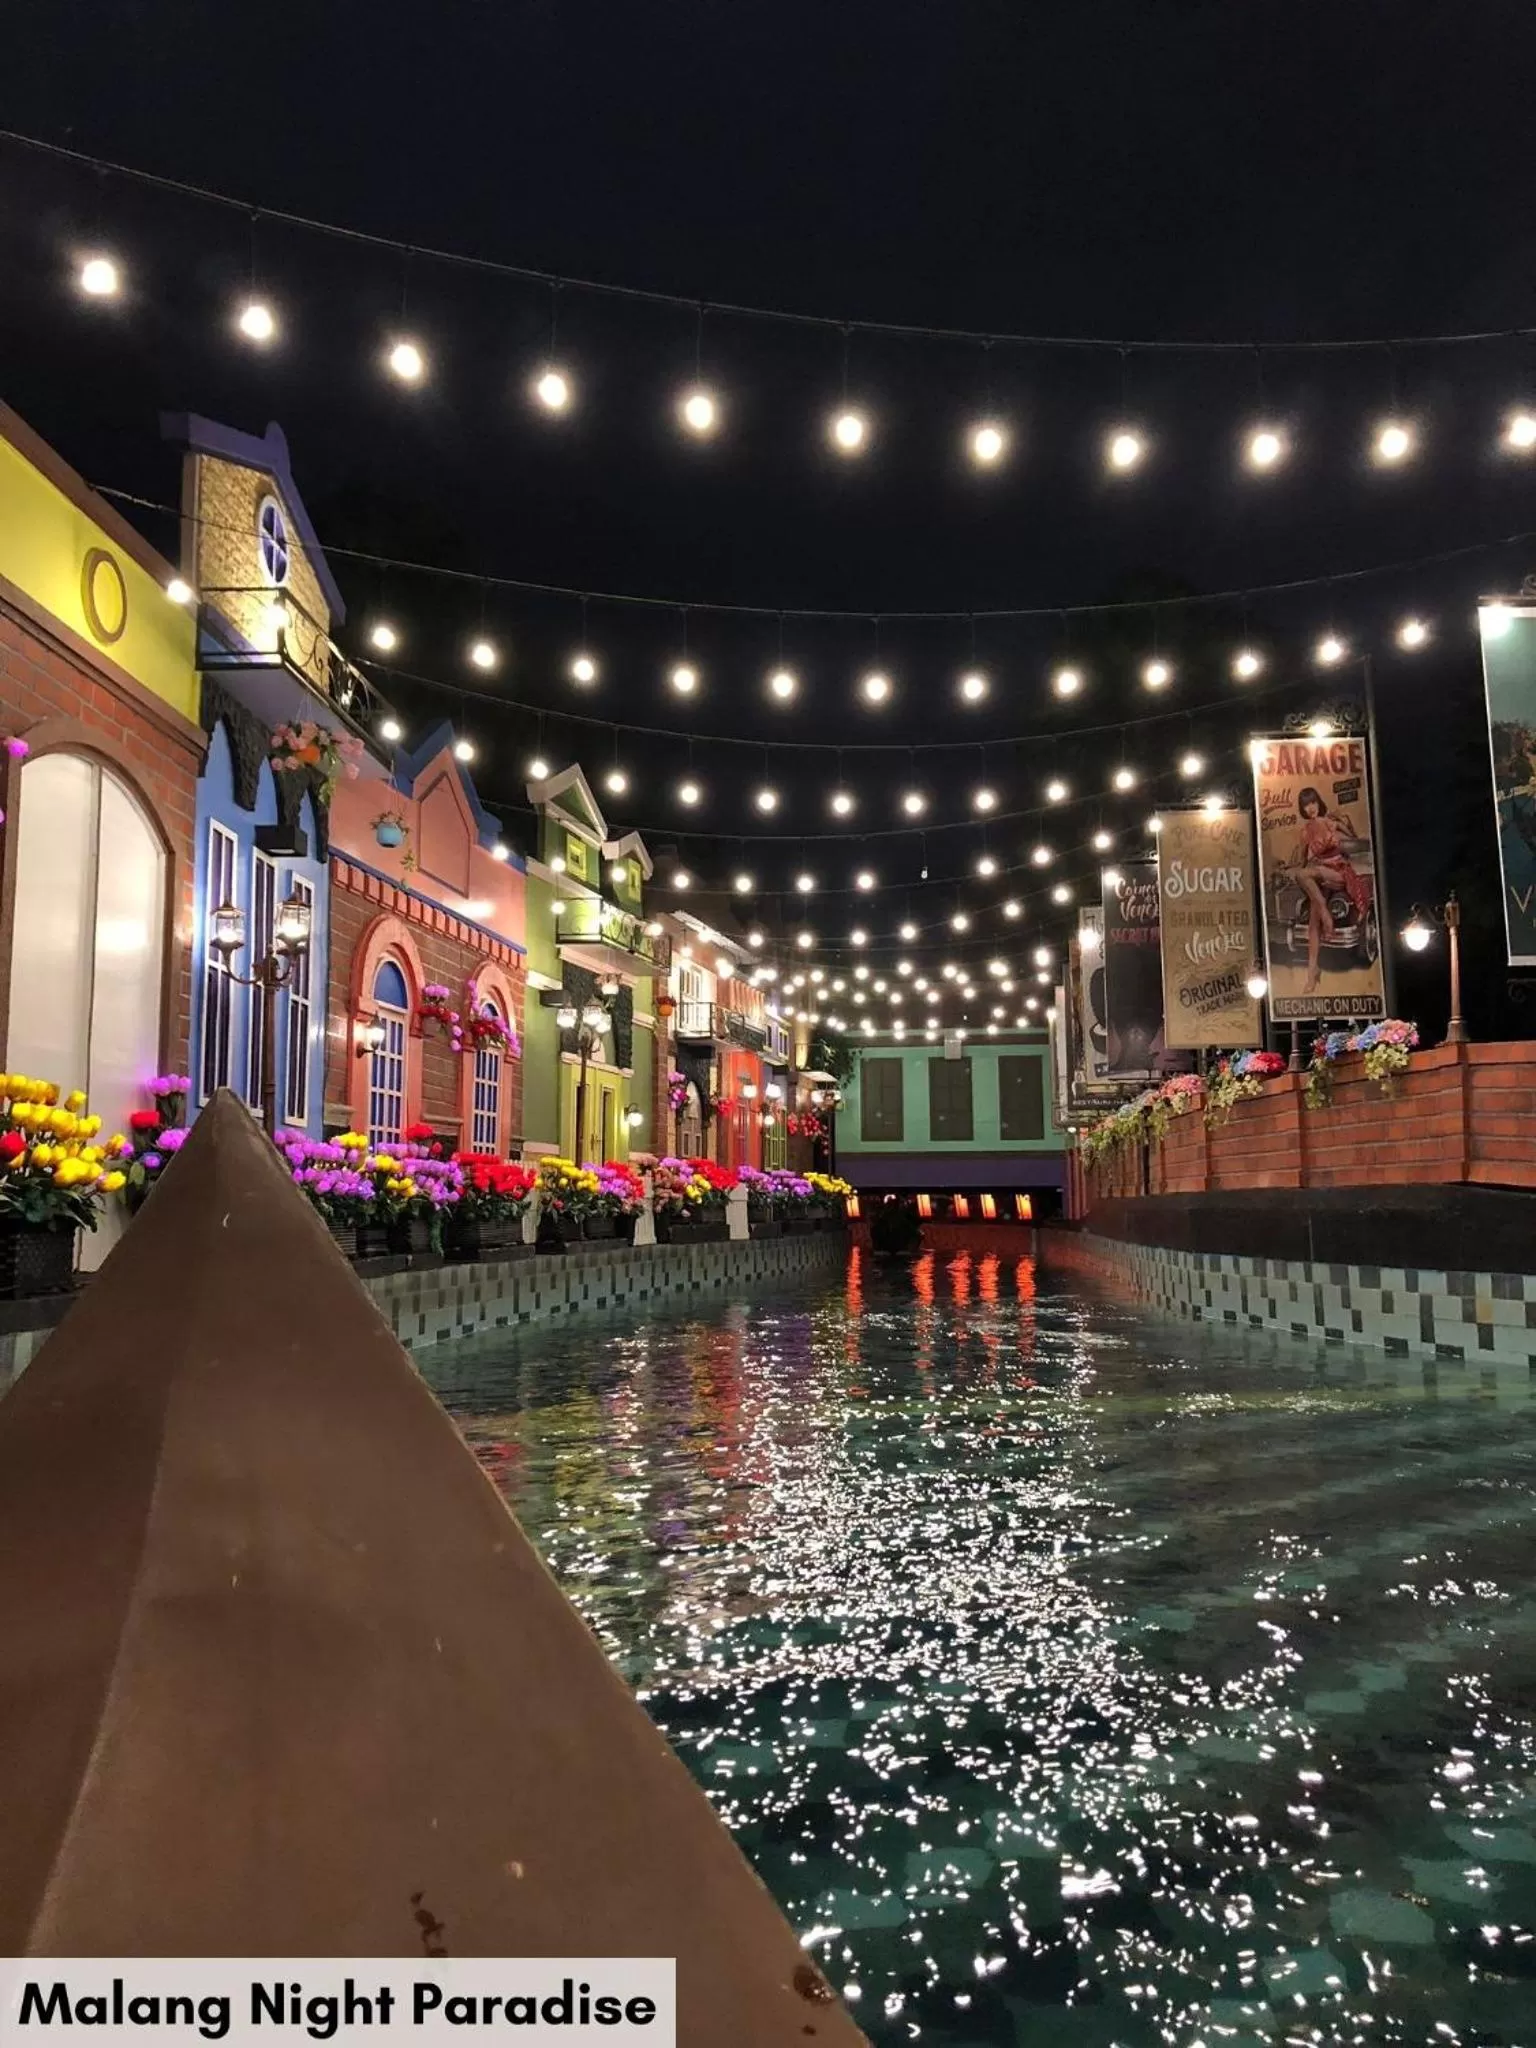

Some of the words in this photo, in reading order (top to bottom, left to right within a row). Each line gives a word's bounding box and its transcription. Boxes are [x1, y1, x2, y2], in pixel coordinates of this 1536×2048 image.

[1258, 742, 1363, 777] GARAGE
[1261, 813, 1297, 831] Service
[1165, 860, 1244, 898] SUGAR
[1170, 909, 1249, 928] GRANULATED
[1179, 972, 1245, 1008] ORIGINAL
[1275, 998, 1332, 1016] MECHANIC
[1333, 998, 1350, 1014] ON
[1352, 997, 1380, 1013] DUTY
